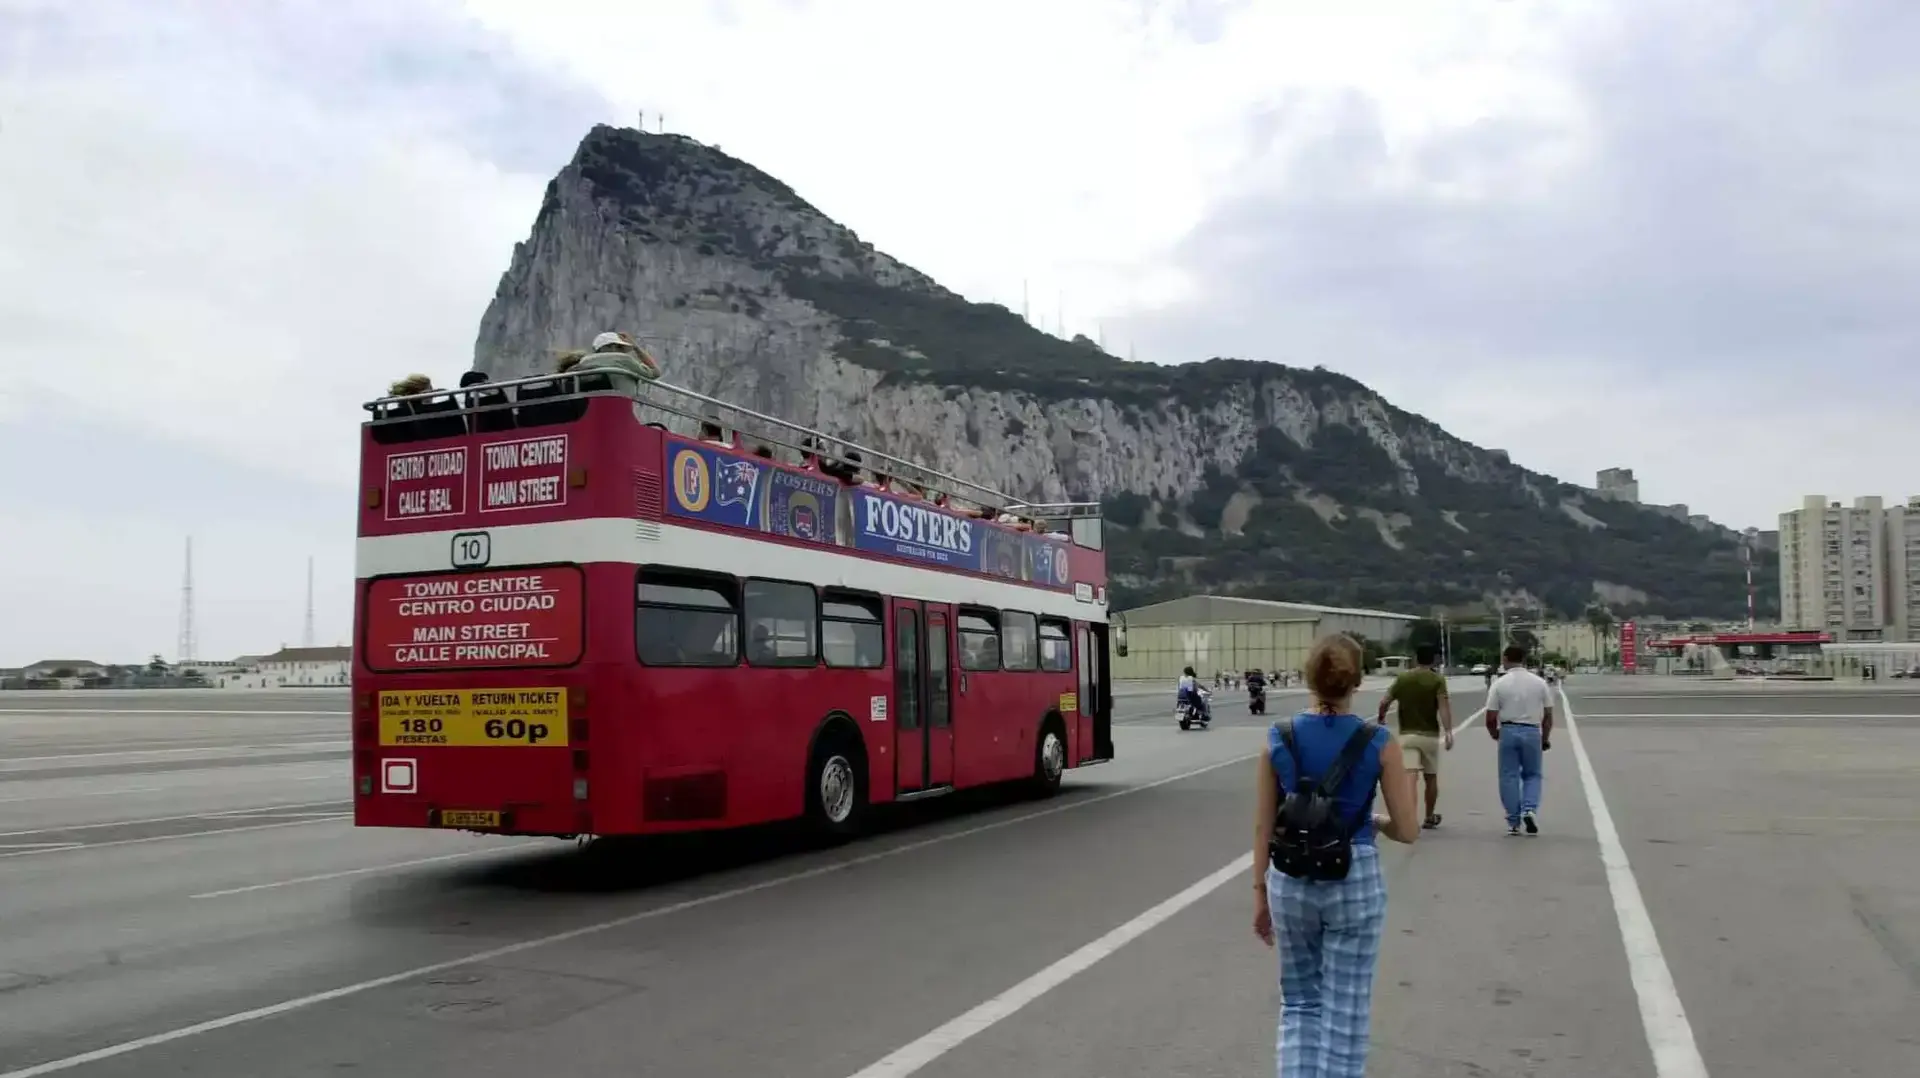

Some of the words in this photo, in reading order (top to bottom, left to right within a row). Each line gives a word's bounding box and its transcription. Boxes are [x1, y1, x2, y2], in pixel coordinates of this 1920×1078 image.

[486, 445, 518, 471] TOWN
[521, 439, 564, 467] CENTRE
[391, 457, 425, 481] CENTRO
[428, 452, 464, 477] CIUDAD
[399, 490, 426, 514] CALLE
[429, 488, 451, 512] REAL
[488, 480, 517, 506] MAIN
[519, 476, 560, 503] STREET
[864, 495, 972, 553] FOSTER'S
[461, 540, 481, 560] 10
[404, 581, 458, 597] TOWN
[464, 576, 542, 593] CENTRE
[399, 600, 475, 616] CENTRO
[480, 595, 555, 612] CIUDAD
[413, 626, 456, 642] MAIN
[461, 623, 530, 640] STREET
[395, 647, 450, 662] CALLE
[455, 643, 550, 660] PRINCIPAL
[381, 695, 400, 707] IDA
[405, 695, 413, 707] Y
[415, 694, 461, 707] VUELTA
[471, 692, 516, 705] RETURN
[518, 692, 560, 705] TICKET
[400, 718, 443, 733] 180
[484, 718, 549, 744] 60p
[395, 734, 447, 745] PESETAS
